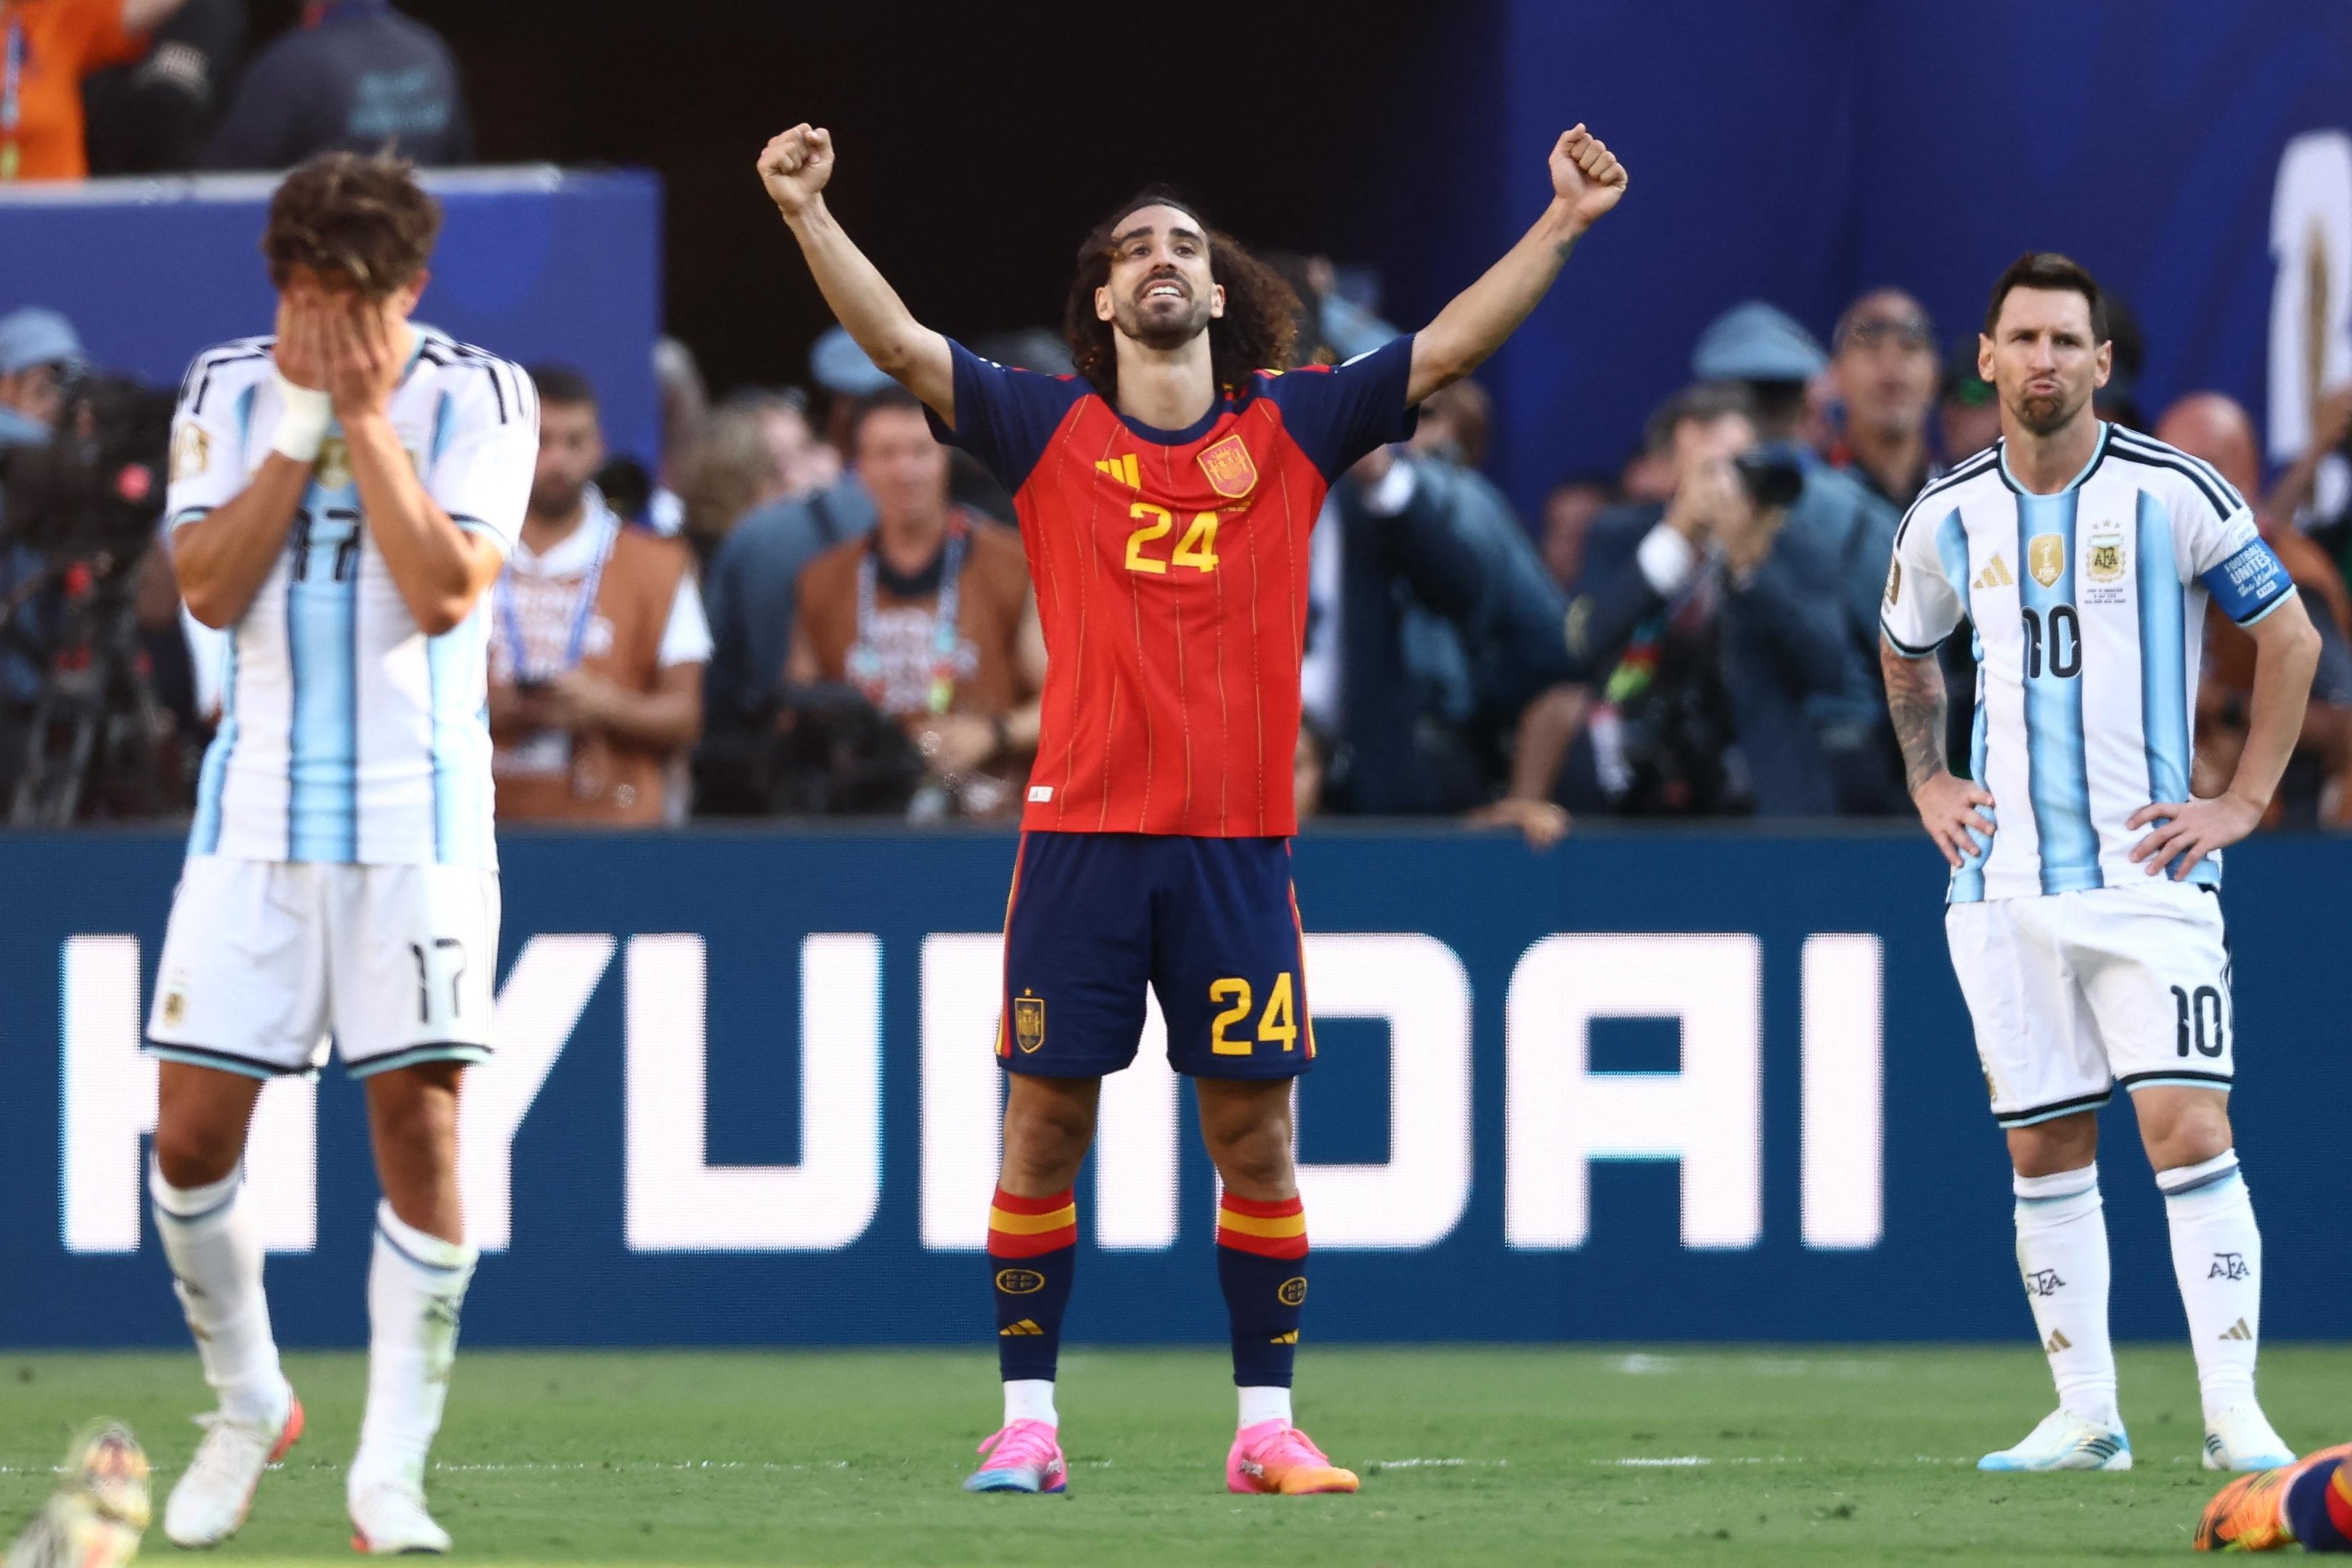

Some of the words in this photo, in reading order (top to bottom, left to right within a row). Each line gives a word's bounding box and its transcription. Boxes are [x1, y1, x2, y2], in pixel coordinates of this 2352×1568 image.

[293, 508, 362, 581] 17
[1125, 502, 1219, 574] 24
[2230, 550, 2271, 585] UNITES
[2021, 603, 2082, 678] 10
[409, 938, 467, 1023] 17
[1210, 972, 1297, 1055] 24
[2170, 984, 2223, 1058] 10
[2207, 1252, 2250, 1281] AFA
